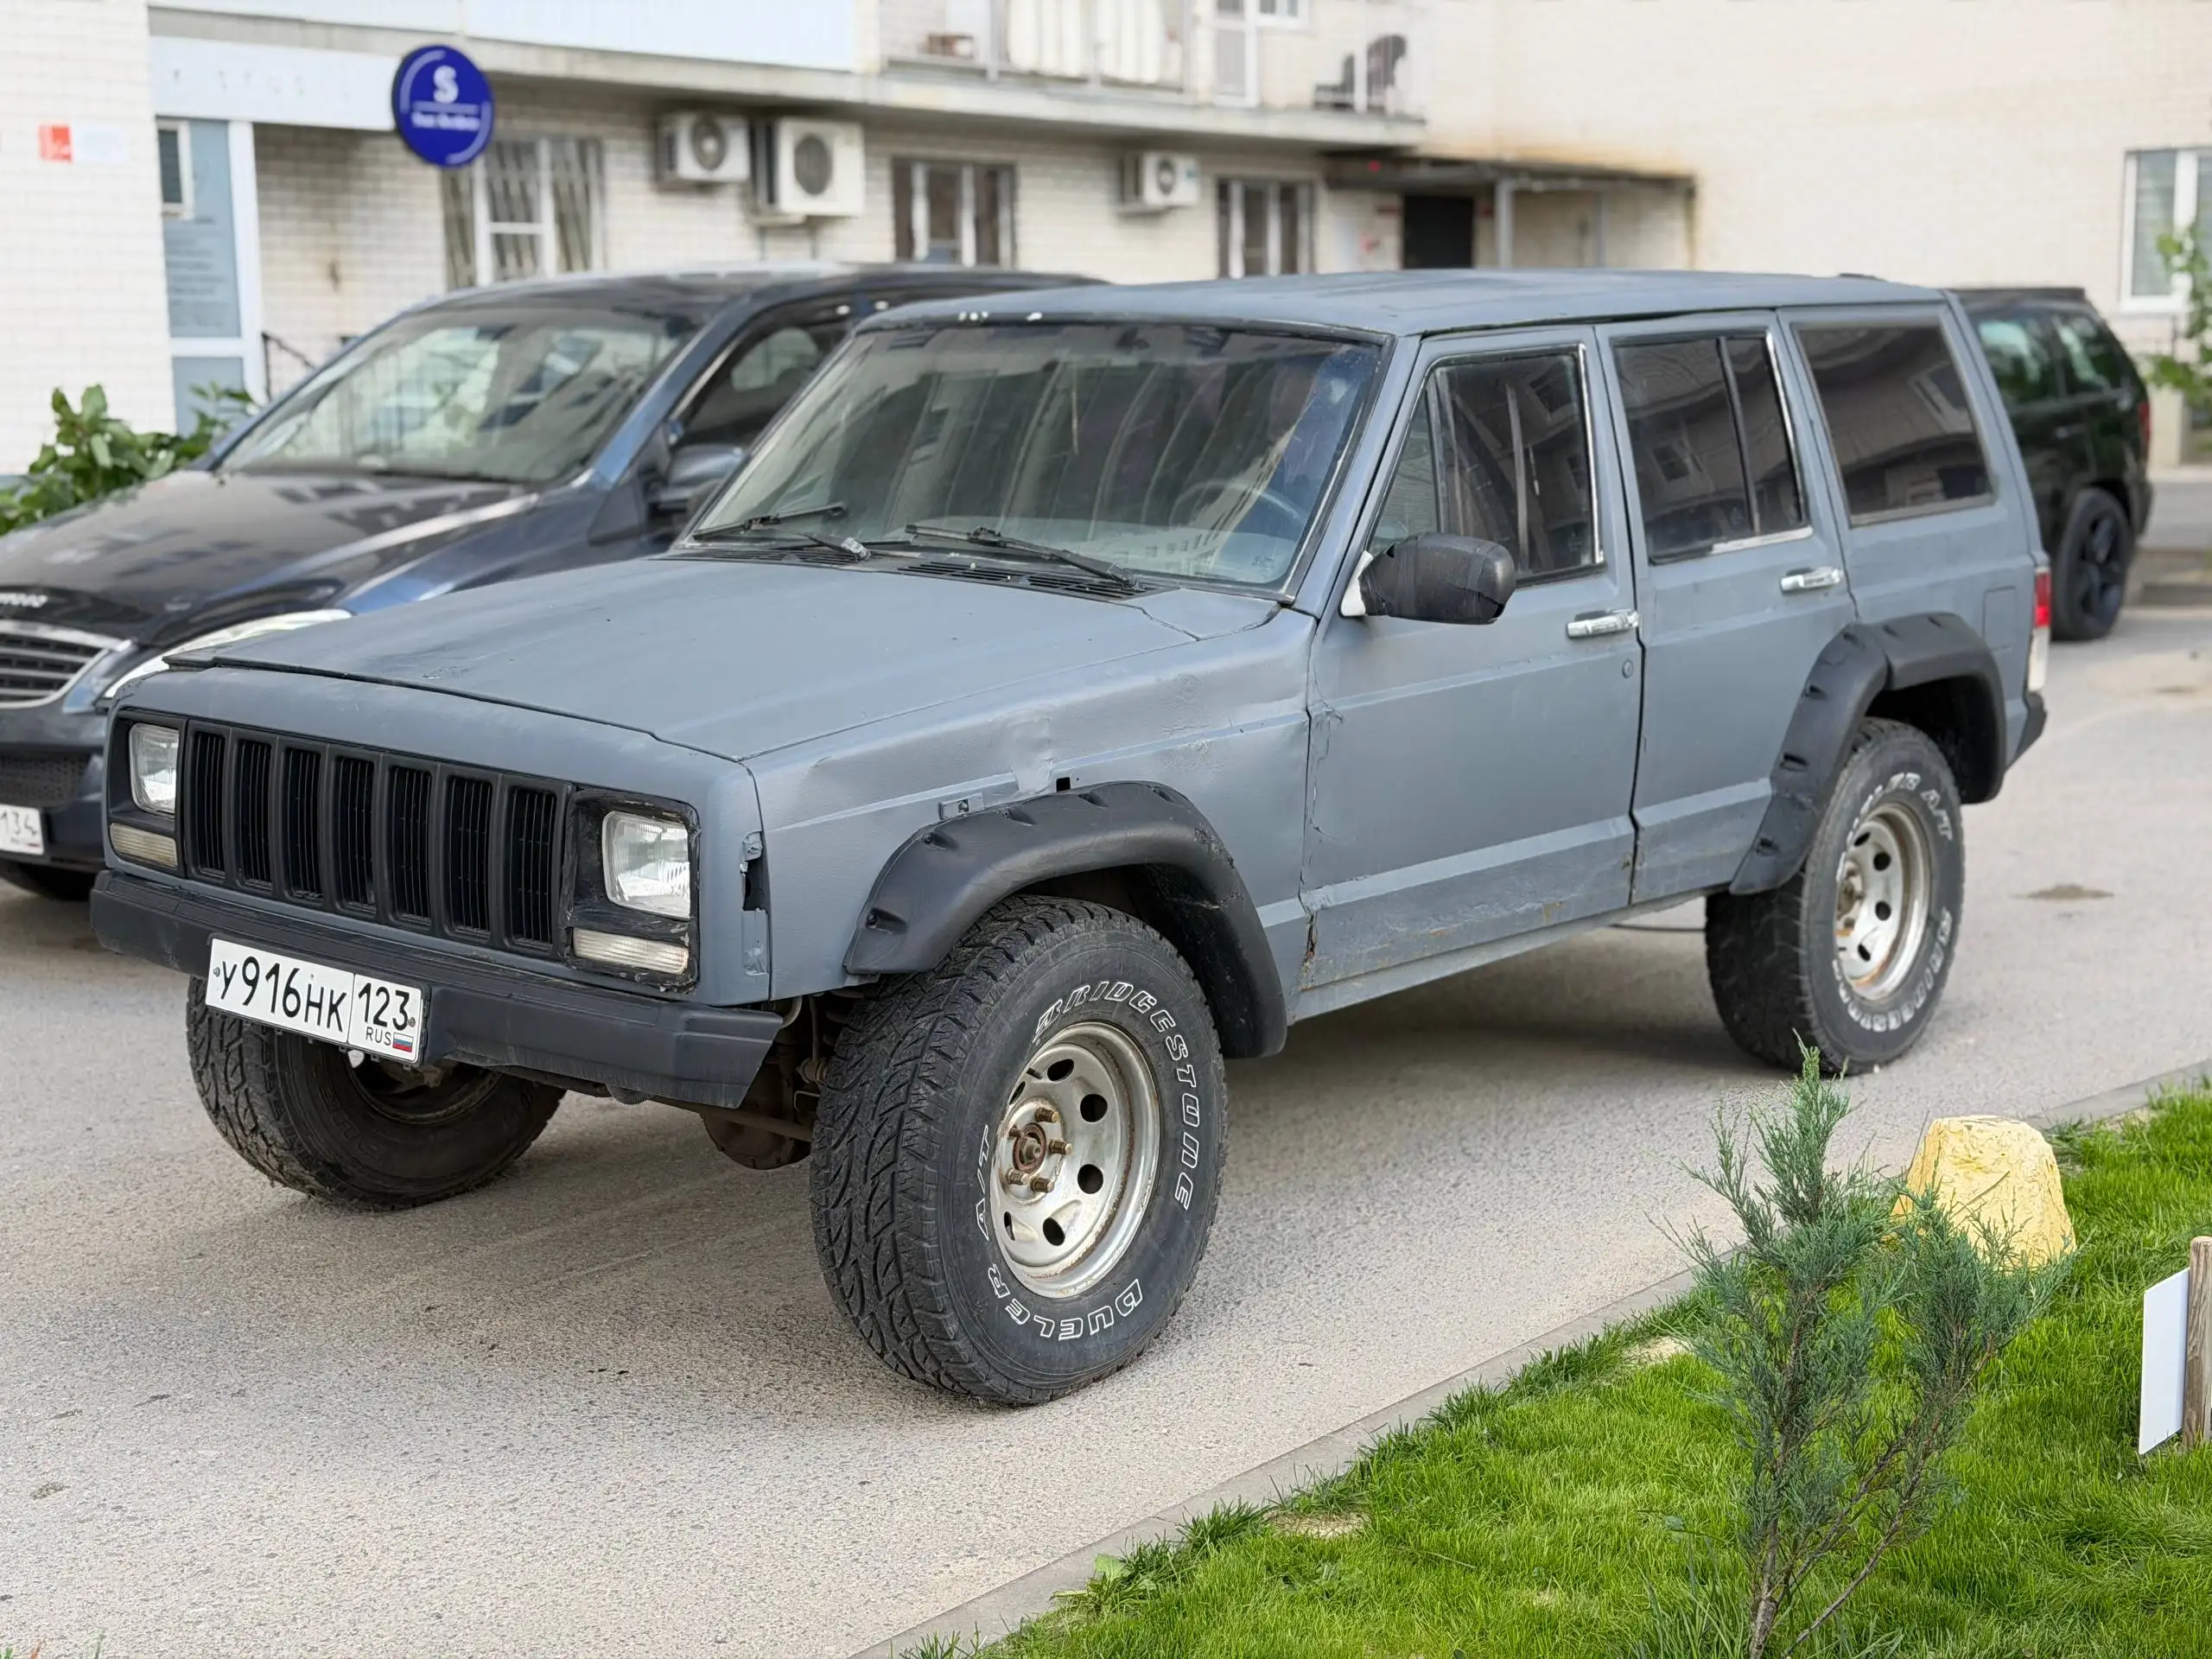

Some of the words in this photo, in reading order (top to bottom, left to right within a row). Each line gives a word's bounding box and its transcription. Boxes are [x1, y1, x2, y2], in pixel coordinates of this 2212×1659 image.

[433, 65, 459, 104] S
[358, 982, 410, 1031] 123
[365, 1027, 391, 1046] RUS
[1032, 981, 1200, 1211] BRIDGESTONE
[988, 1262, 1143, 1341] DUELER
